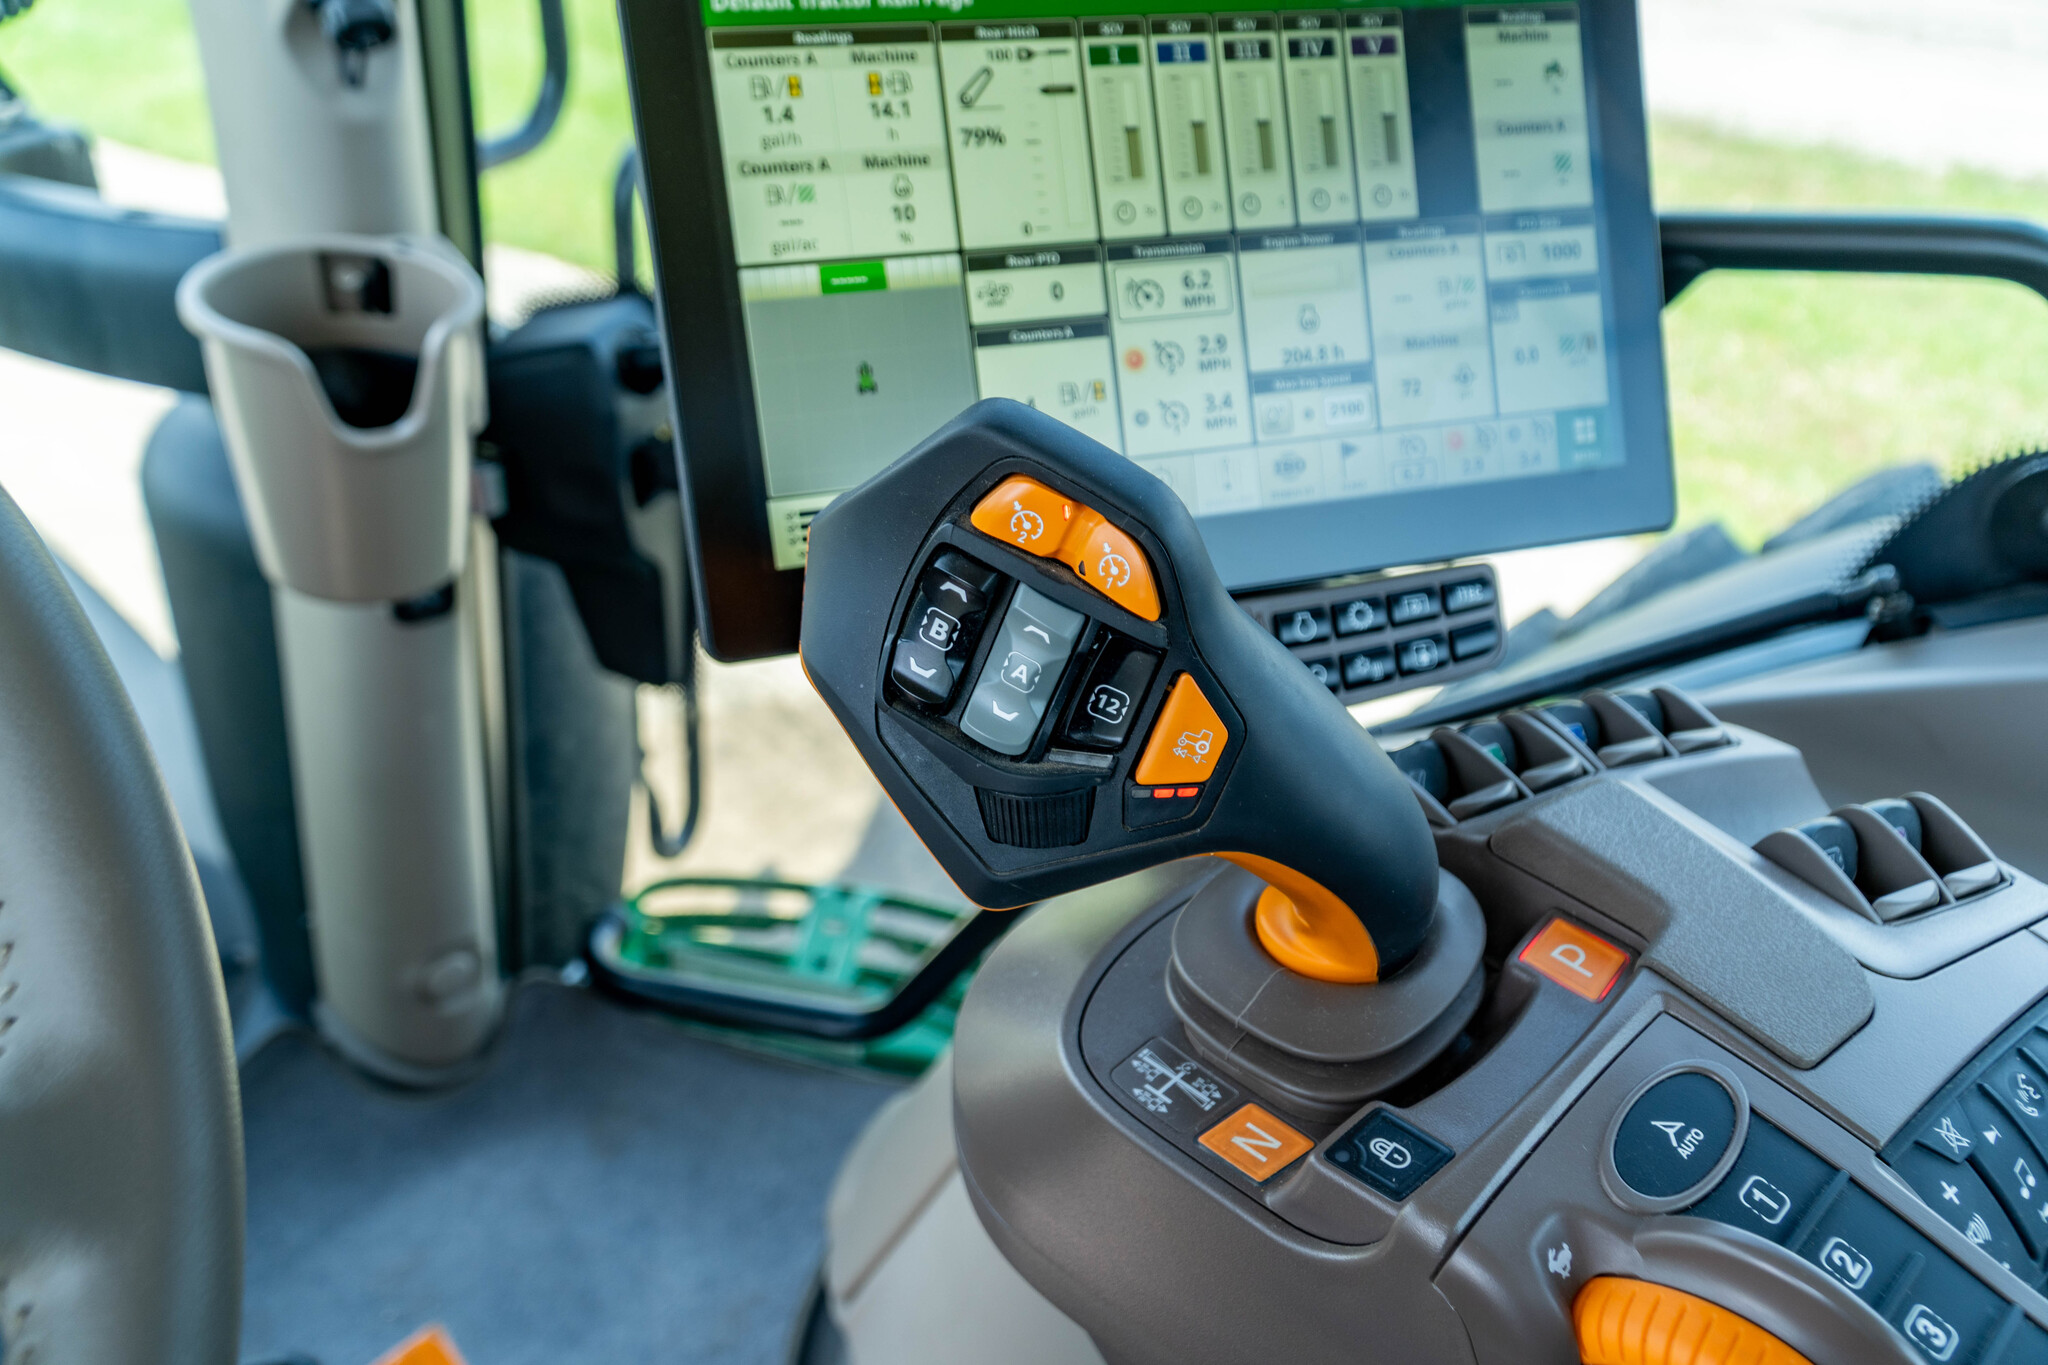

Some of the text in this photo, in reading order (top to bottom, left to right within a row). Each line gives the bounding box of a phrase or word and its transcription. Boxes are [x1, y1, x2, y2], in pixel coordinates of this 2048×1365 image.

[1366, 36, 1383, 54] V
[1497, 29, 1550, 43] Machine
[851, 48, 918, 64] Machine
[1299, 38, 1324, 56] IV
[725, 52, 818, 68] Counters A
[762, 104, 795, 123] 1.4
[870, 101, 911, 119] 14.1
[960, 127, 1006, 146] 79%
[739, 159, 831, 176] Counters A
[863, 153, 931, 169] Machine
[891, 205, 915, 222] 10
[1132, 241, 1206, 258] Transmission
[1541, 243, 1582, 262] 1000
[1005, 254, 1034, 268] Rear
[1181, 269, 1213, 289] 6.2
[1050, 281, 1064, 301] 0
[1181, 293, 1216, 309] MPH
[1008, 327, 1063, 344] Counters
[1198, 355, 1232, 374] MPH
[1282, 345, 1330, 366] 204.8
[1204, 414, 1238, 431] MPH
[1017, 530, 1028, 544] 2
[1106, 576, 1115, 589] 1
[929, 621, 950, 642] B
[1010, 664, 1028, 684] A
[1097, 693, 1121, 715] 12
[1550, 943, 1594, 979] P
[1231, 1123, 1279, 1163] N
[1677, 1127, 1705, 1161] AUTO
[1753, 1189, 1781, 1211] 1
[1830, 1248, 1862, 1279] 2
[1916, 1317, 1948, 1346] 3
